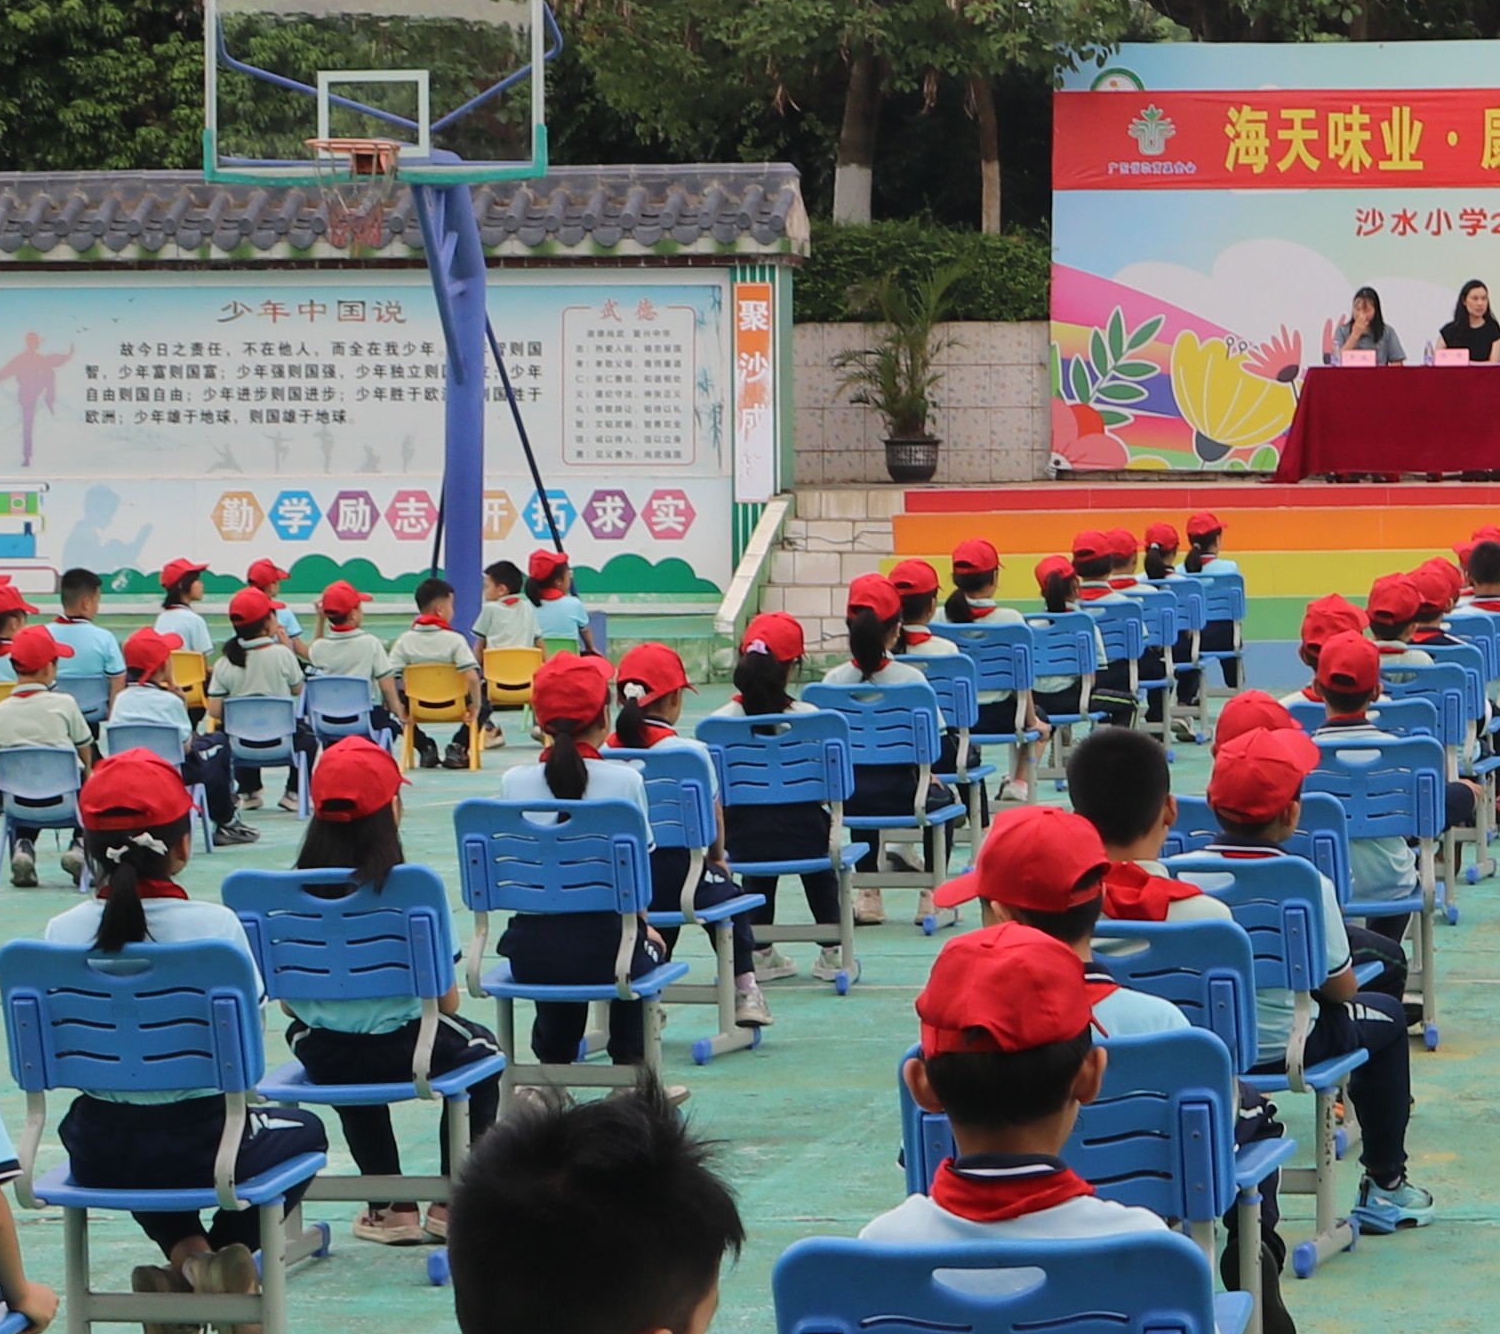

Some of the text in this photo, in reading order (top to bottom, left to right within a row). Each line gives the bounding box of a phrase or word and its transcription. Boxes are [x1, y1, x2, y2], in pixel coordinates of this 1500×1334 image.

[217, 298, 407, 324] 少年中国说
[221, 495, 686, 534] 勤学励志 开拓求实
